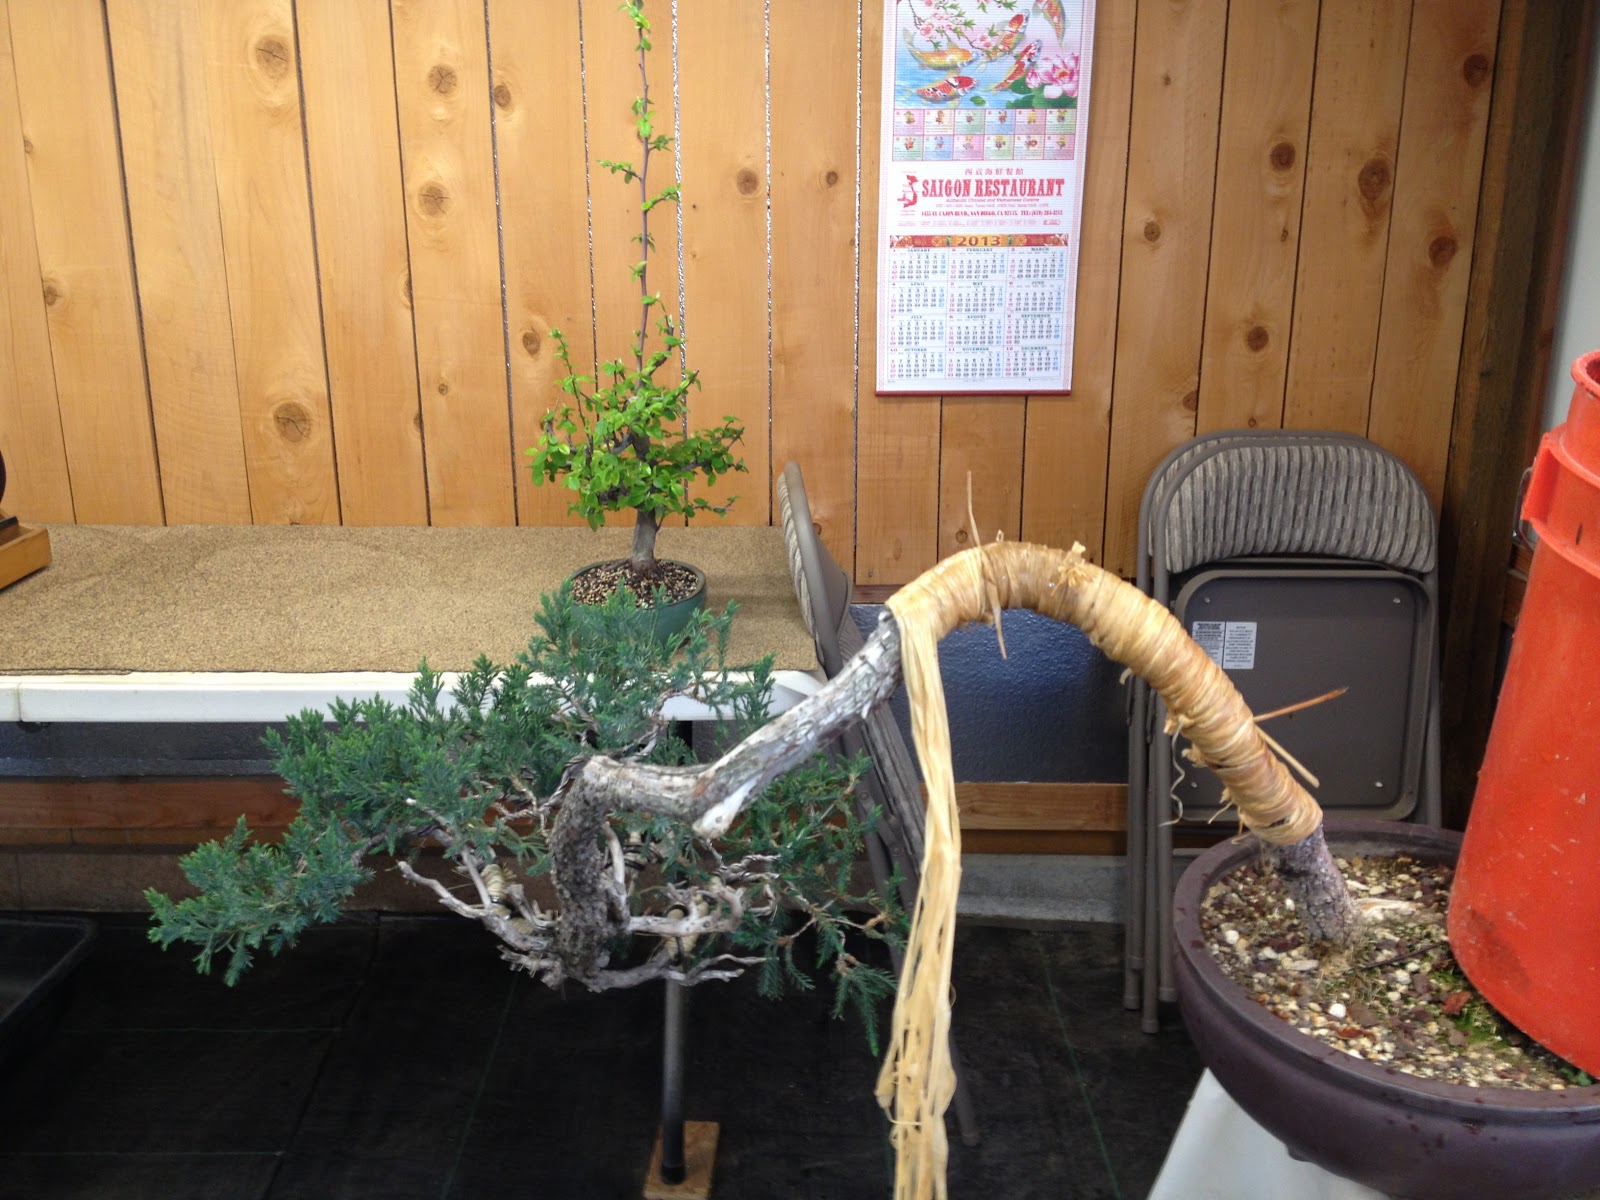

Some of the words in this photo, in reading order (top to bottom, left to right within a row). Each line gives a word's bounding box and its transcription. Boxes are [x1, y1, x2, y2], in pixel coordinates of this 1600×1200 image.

[921, 179, 971, 198] SAIGON
[974, 178, 1065, 197] RESTAURANT
[957, 235, 1001, 247] 2013
